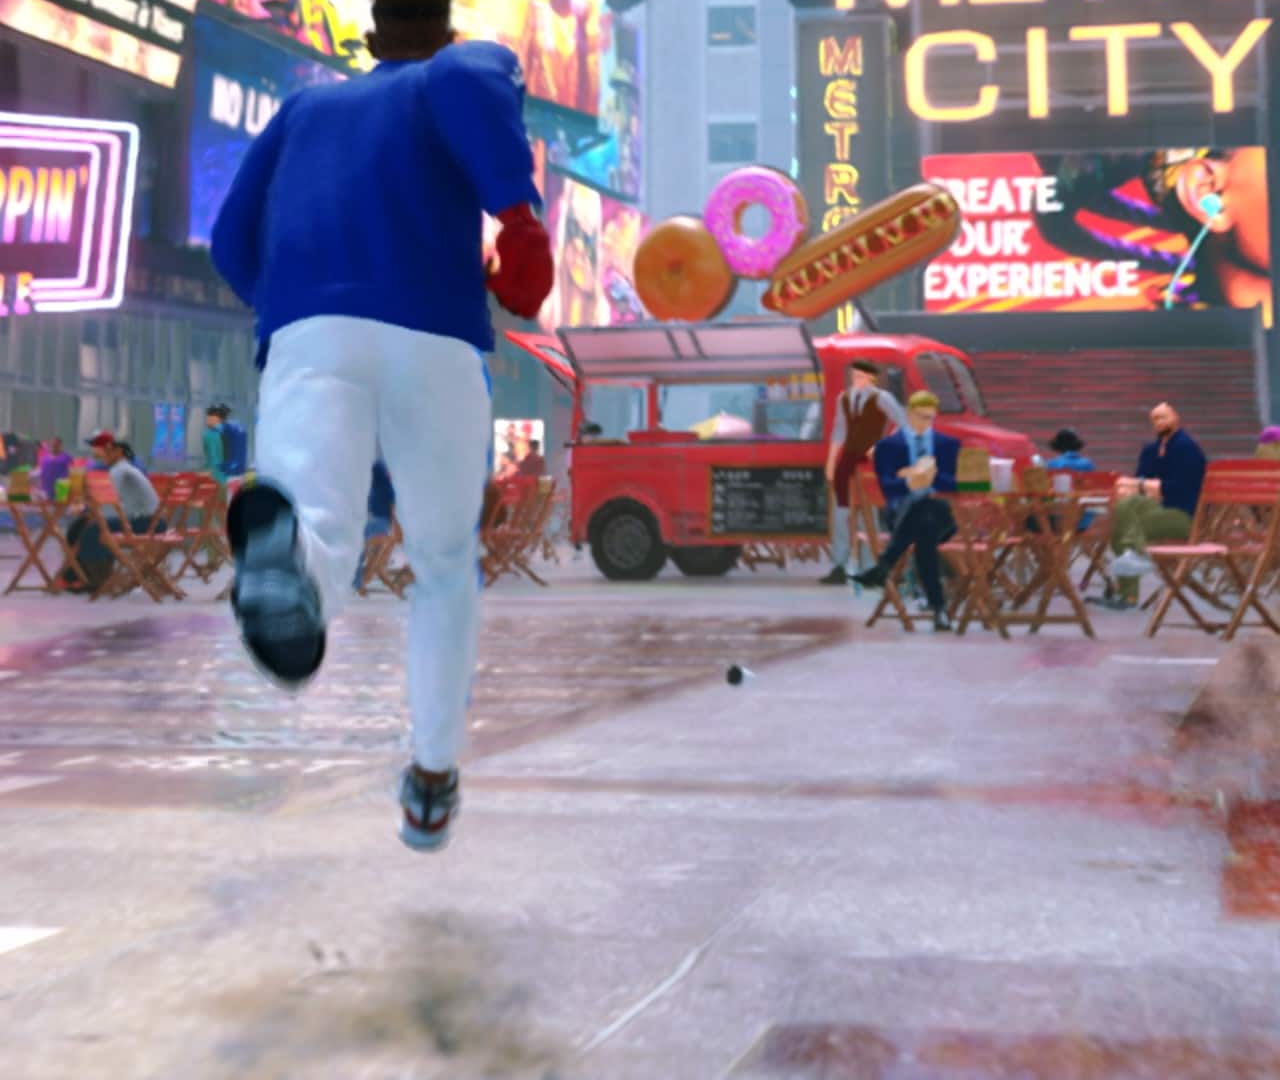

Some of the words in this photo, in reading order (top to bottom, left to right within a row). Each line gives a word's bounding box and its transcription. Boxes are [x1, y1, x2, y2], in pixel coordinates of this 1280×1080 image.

[904, 18, 1273, 122] CITY
[929, 176, 1064, 213] REATE
[949, 218, 1032, 257] OUR
[924, 260, 1140, 300] EXPERIENCE
